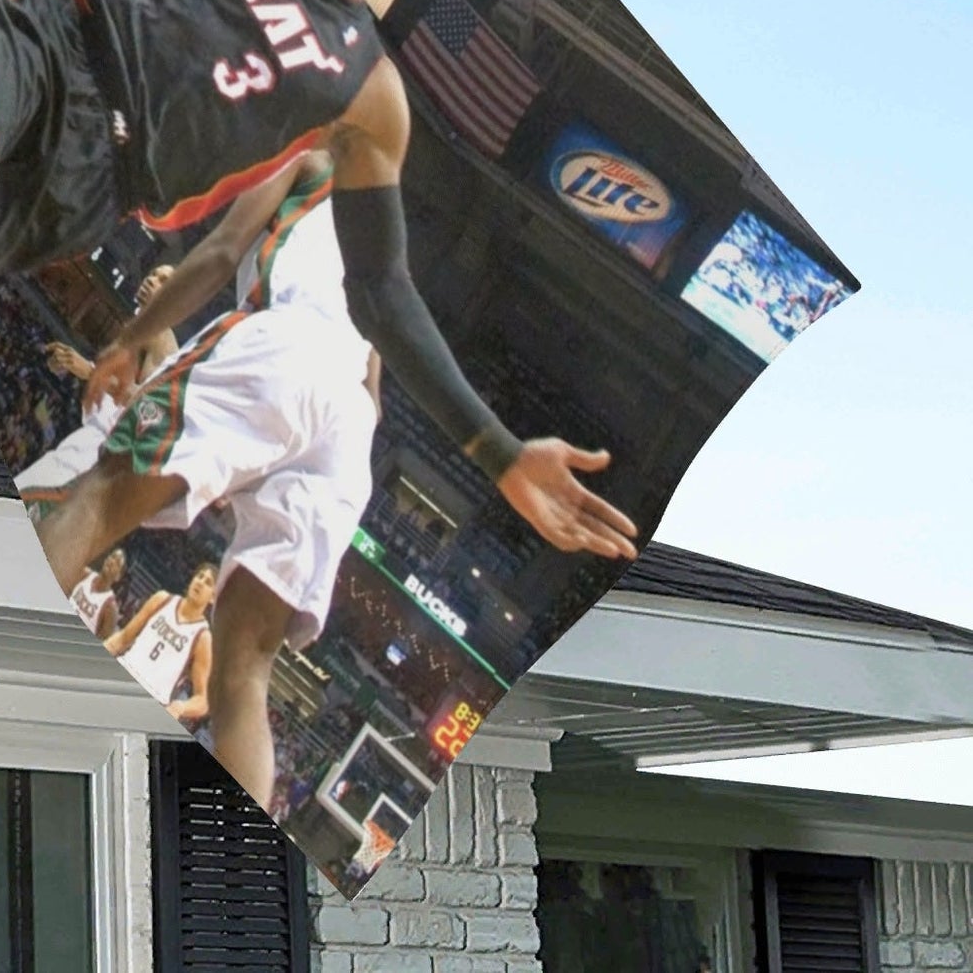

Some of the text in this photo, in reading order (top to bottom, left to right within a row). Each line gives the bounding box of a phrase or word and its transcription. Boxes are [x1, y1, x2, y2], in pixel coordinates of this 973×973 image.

[212, 52, 274, 100] 3
[562, 166, 661, 216] Lite
[404, 573, 467, 637] BUCKS
[149, 641, 166, 662] 6
